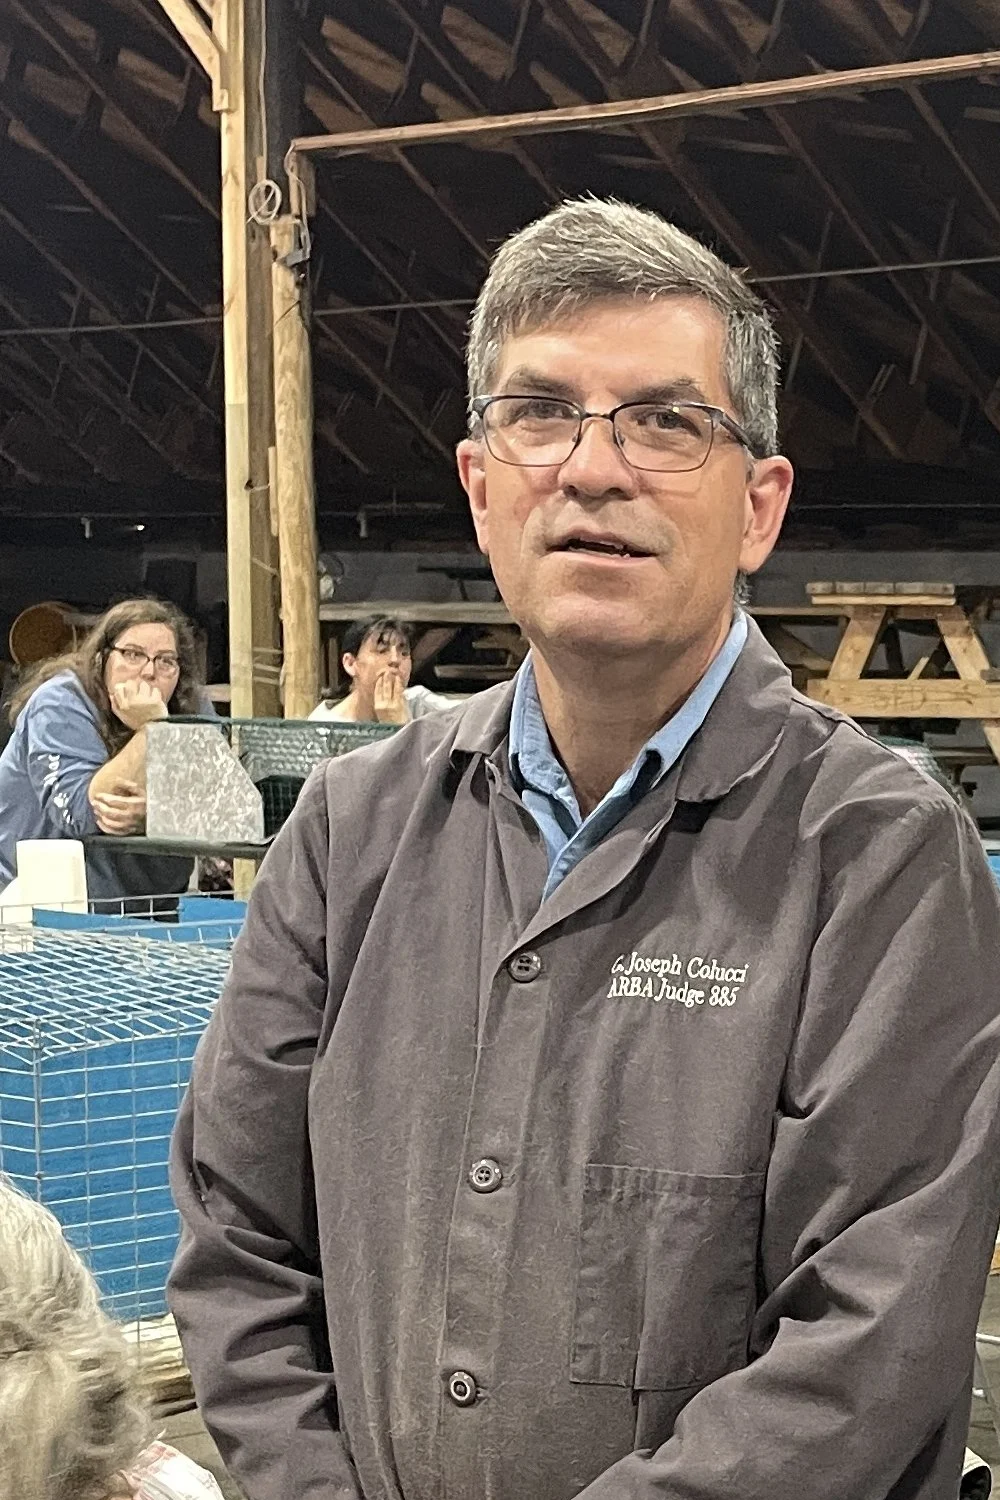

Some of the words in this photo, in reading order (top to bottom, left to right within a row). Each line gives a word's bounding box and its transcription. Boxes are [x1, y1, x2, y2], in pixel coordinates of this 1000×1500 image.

[624, 951, 682, 977] Joseph
[687, 956, 750, 983] Colucci
[606, 975, 654, 999] ARBA
[653, 977, 705, 1008] Judge
[708, 984, 740, 1007] 885
